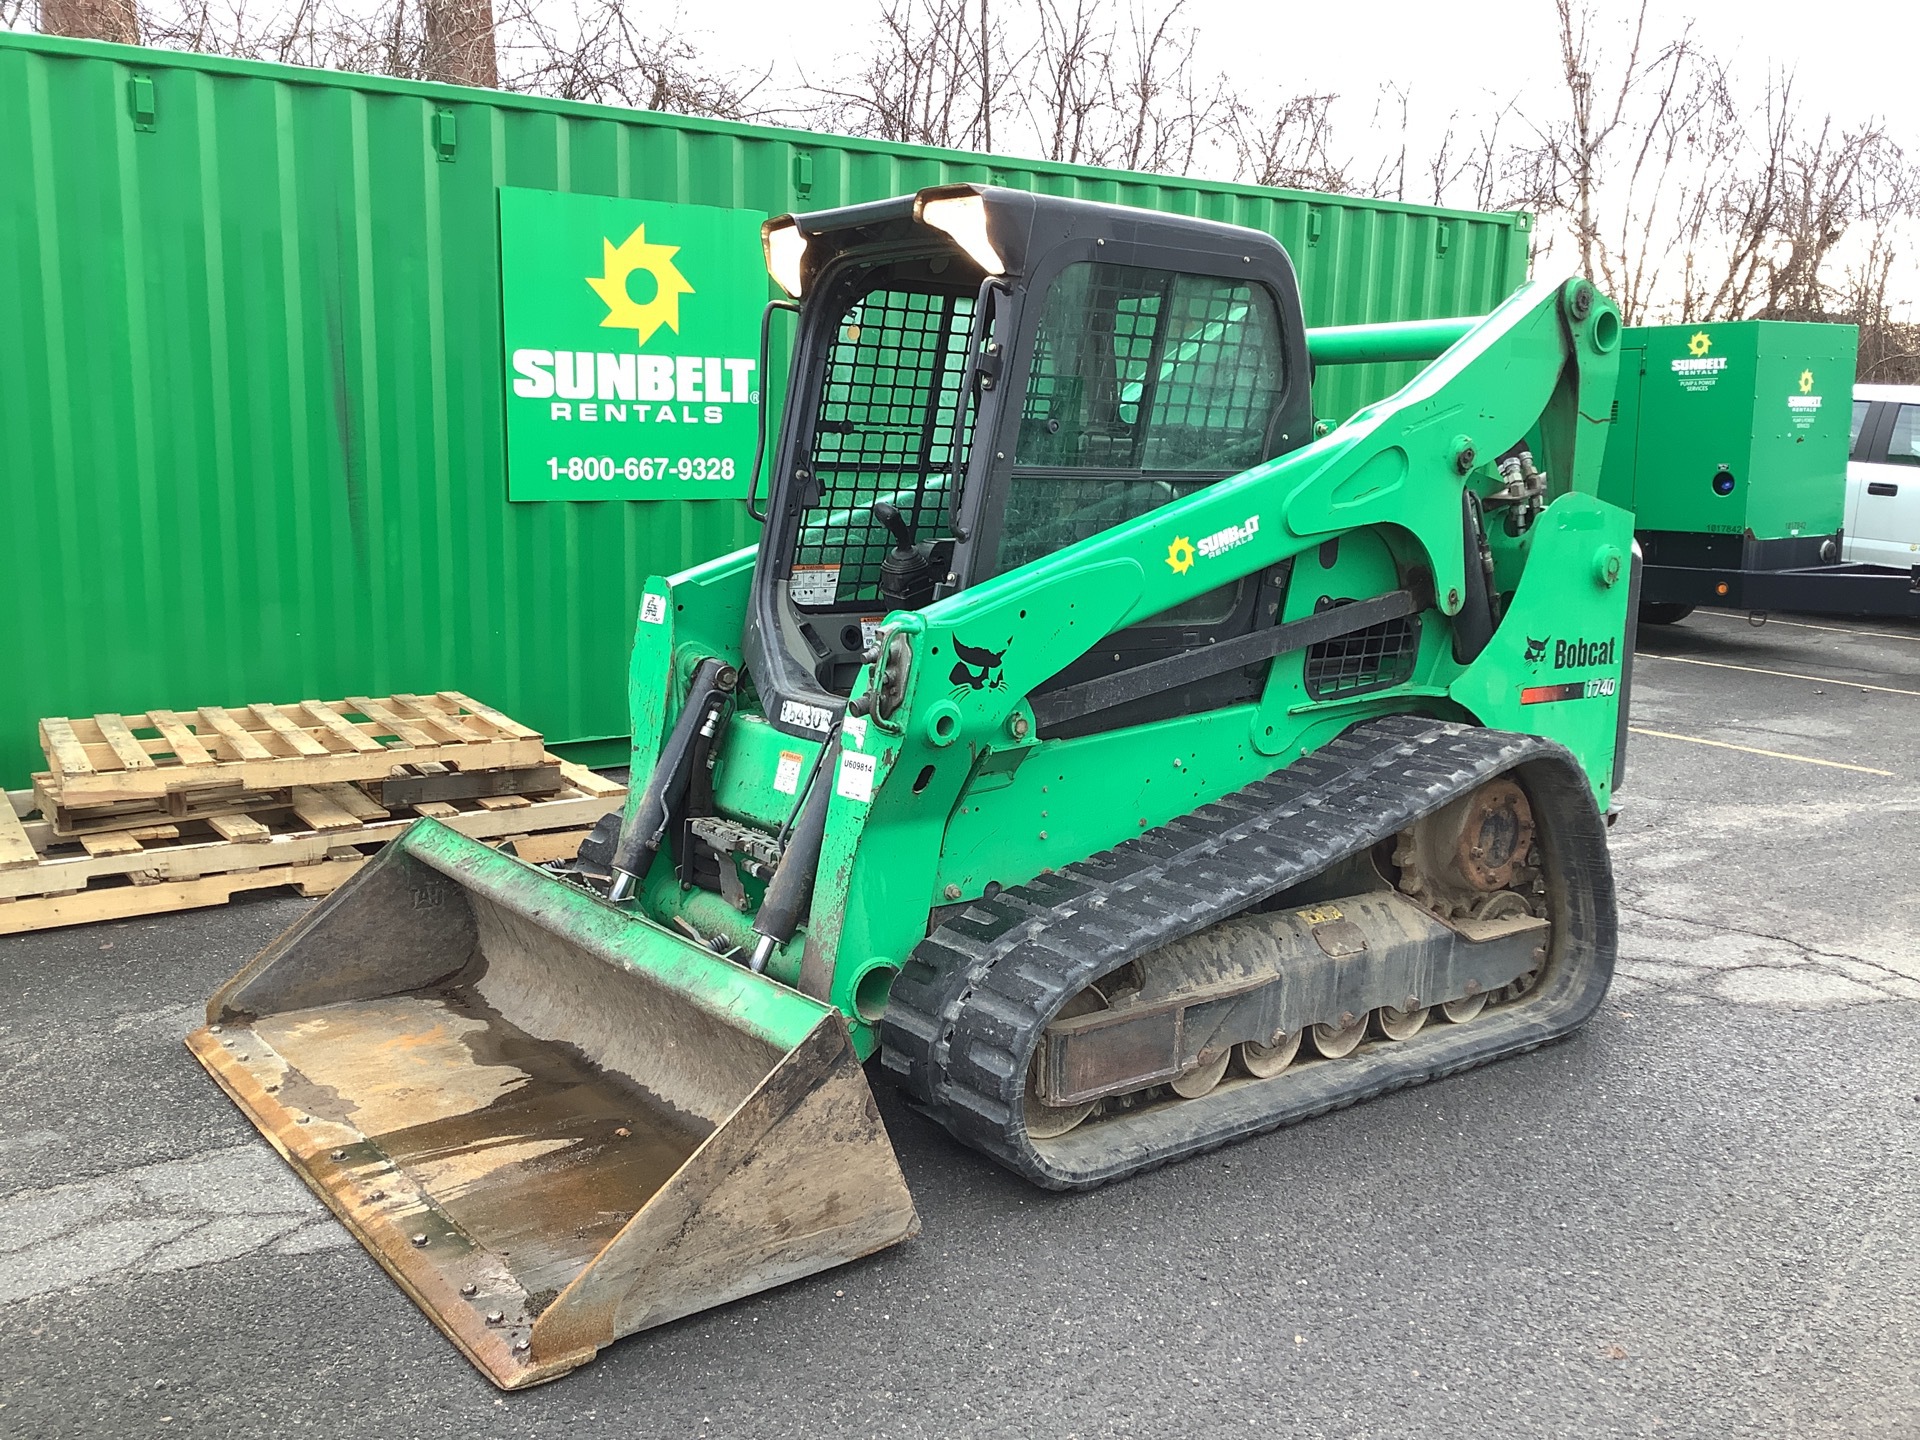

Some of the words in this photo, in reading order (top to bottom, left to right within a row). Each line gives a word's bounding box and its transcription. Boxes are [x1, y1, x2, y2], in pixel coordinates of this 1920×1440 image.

[513, 349, 756, 403] SUNBELT
[1671, 358, 1727, 371] SUNBELT
[550, 402, 723, 424] RENTALS
[546, 456, 735, 481] 1-800-667-9328
[1706, 524, 1742, 534] 1017842
[1207, 532, 1254, 559] RENTALS
[1554, 636, 1615, 669] Bobcat
[844, 759, 873, 773] U609814
